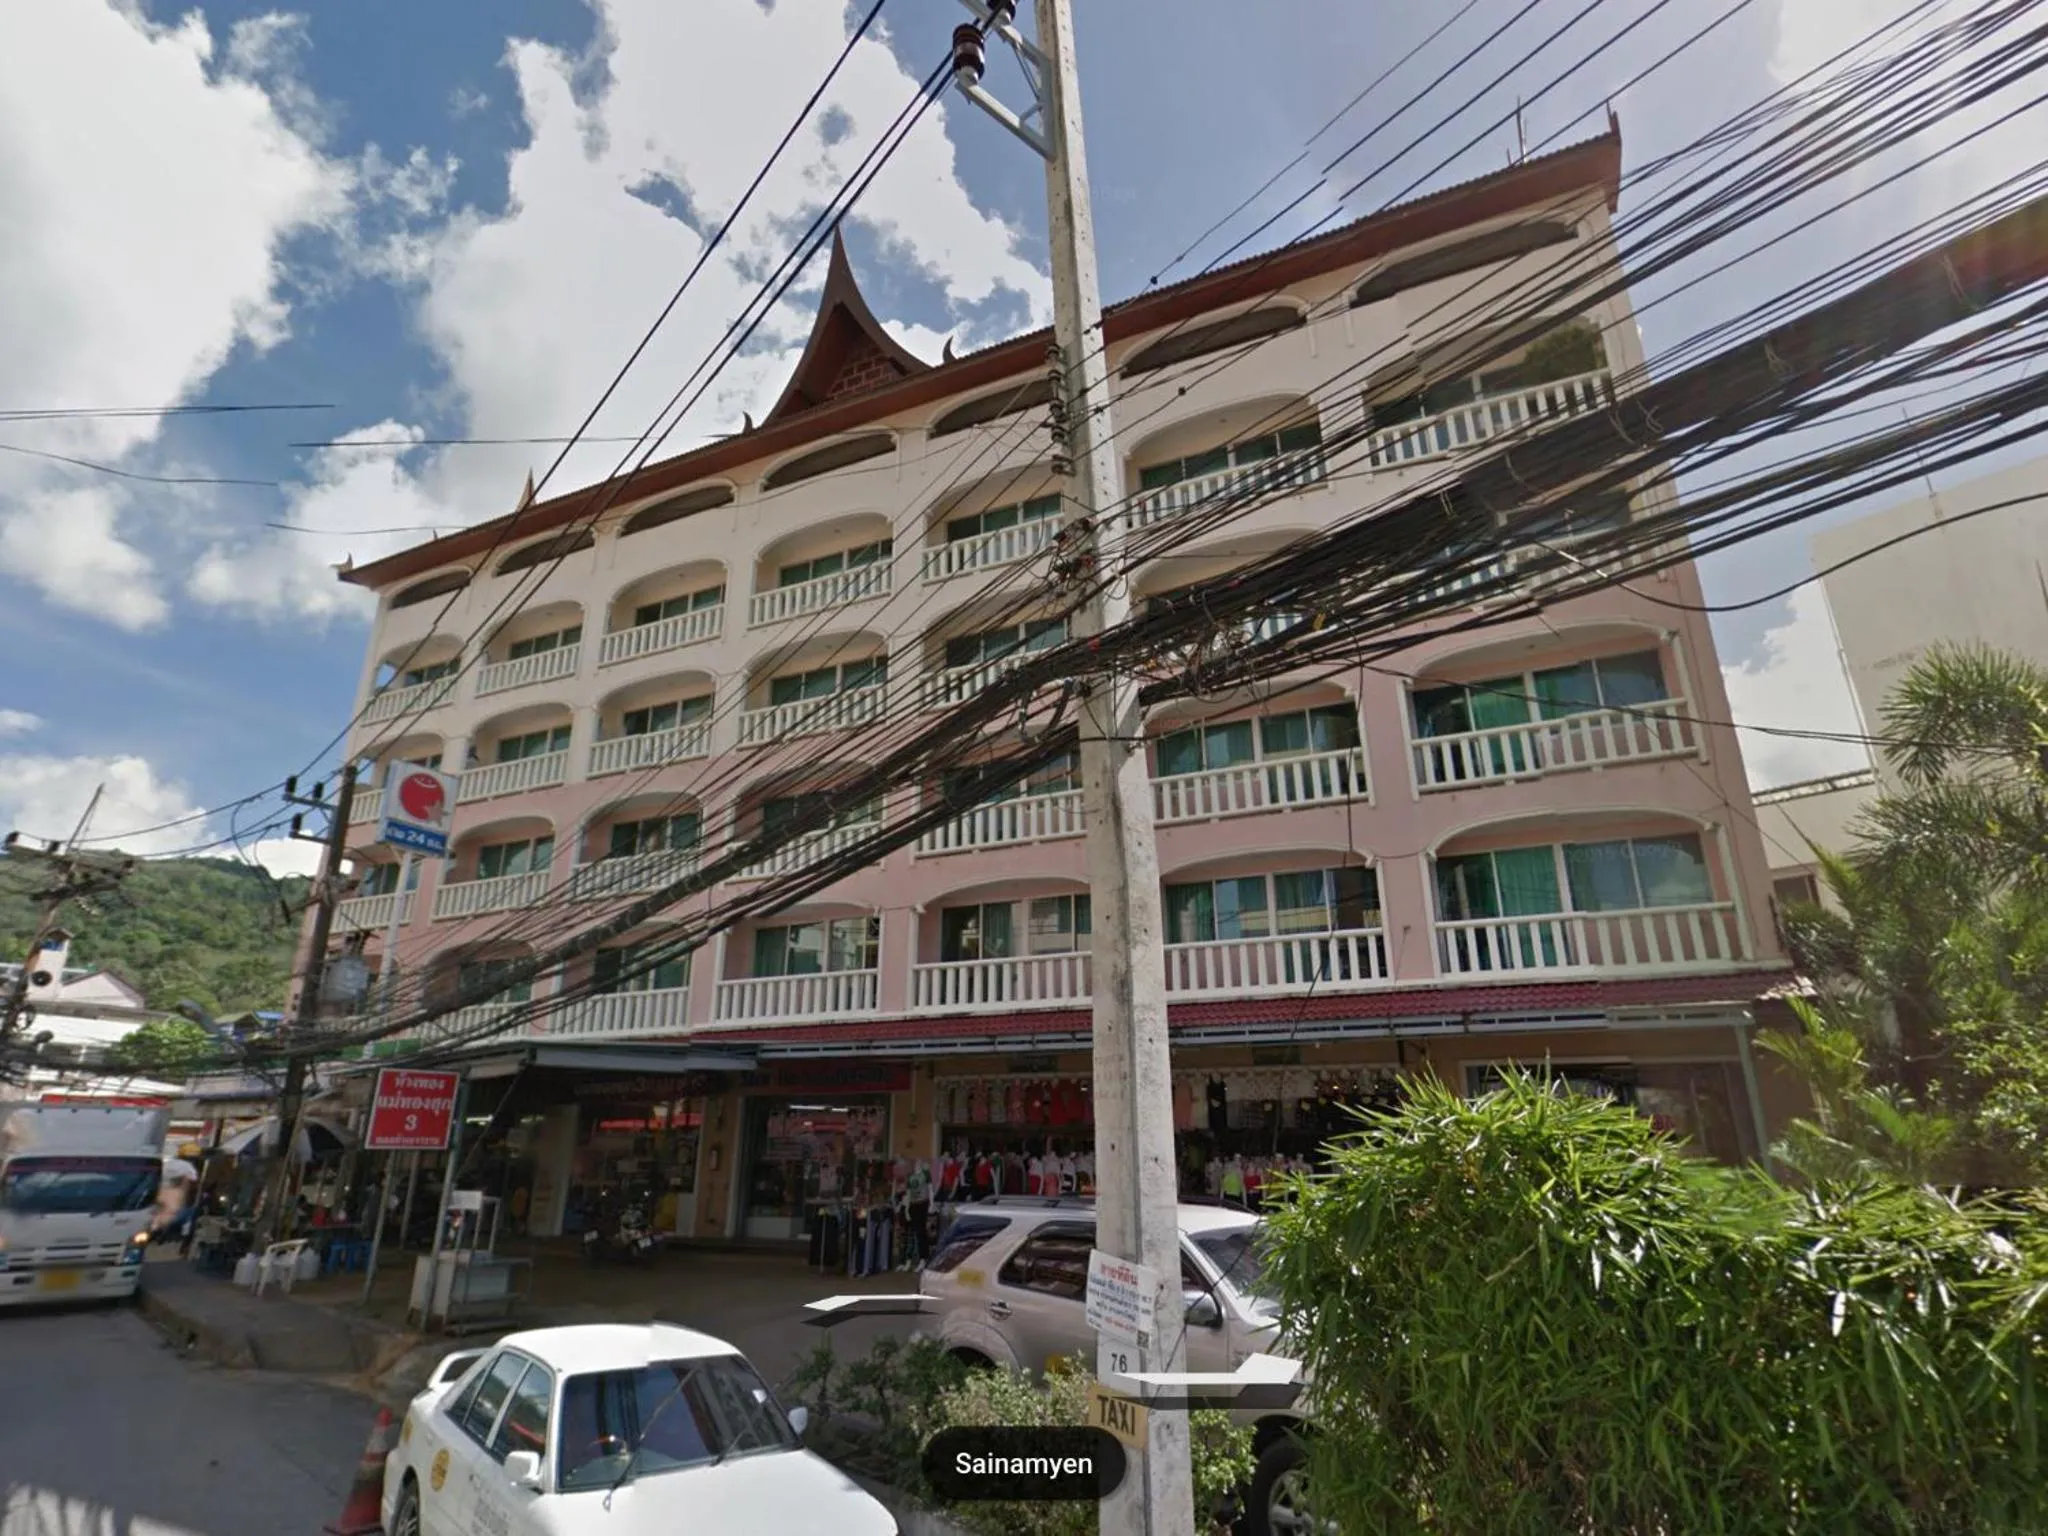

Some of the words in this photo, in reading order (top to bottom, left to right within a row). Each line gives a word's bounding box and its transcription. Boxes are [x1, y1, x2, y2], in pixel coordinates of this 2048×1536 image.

[407, 830, 425, 843] 24
[404, 1114, 418, 1131] 3
[1111, 1353, 1128, 1373] 76
[1097, 1395, 1136, 1436] TAXI
